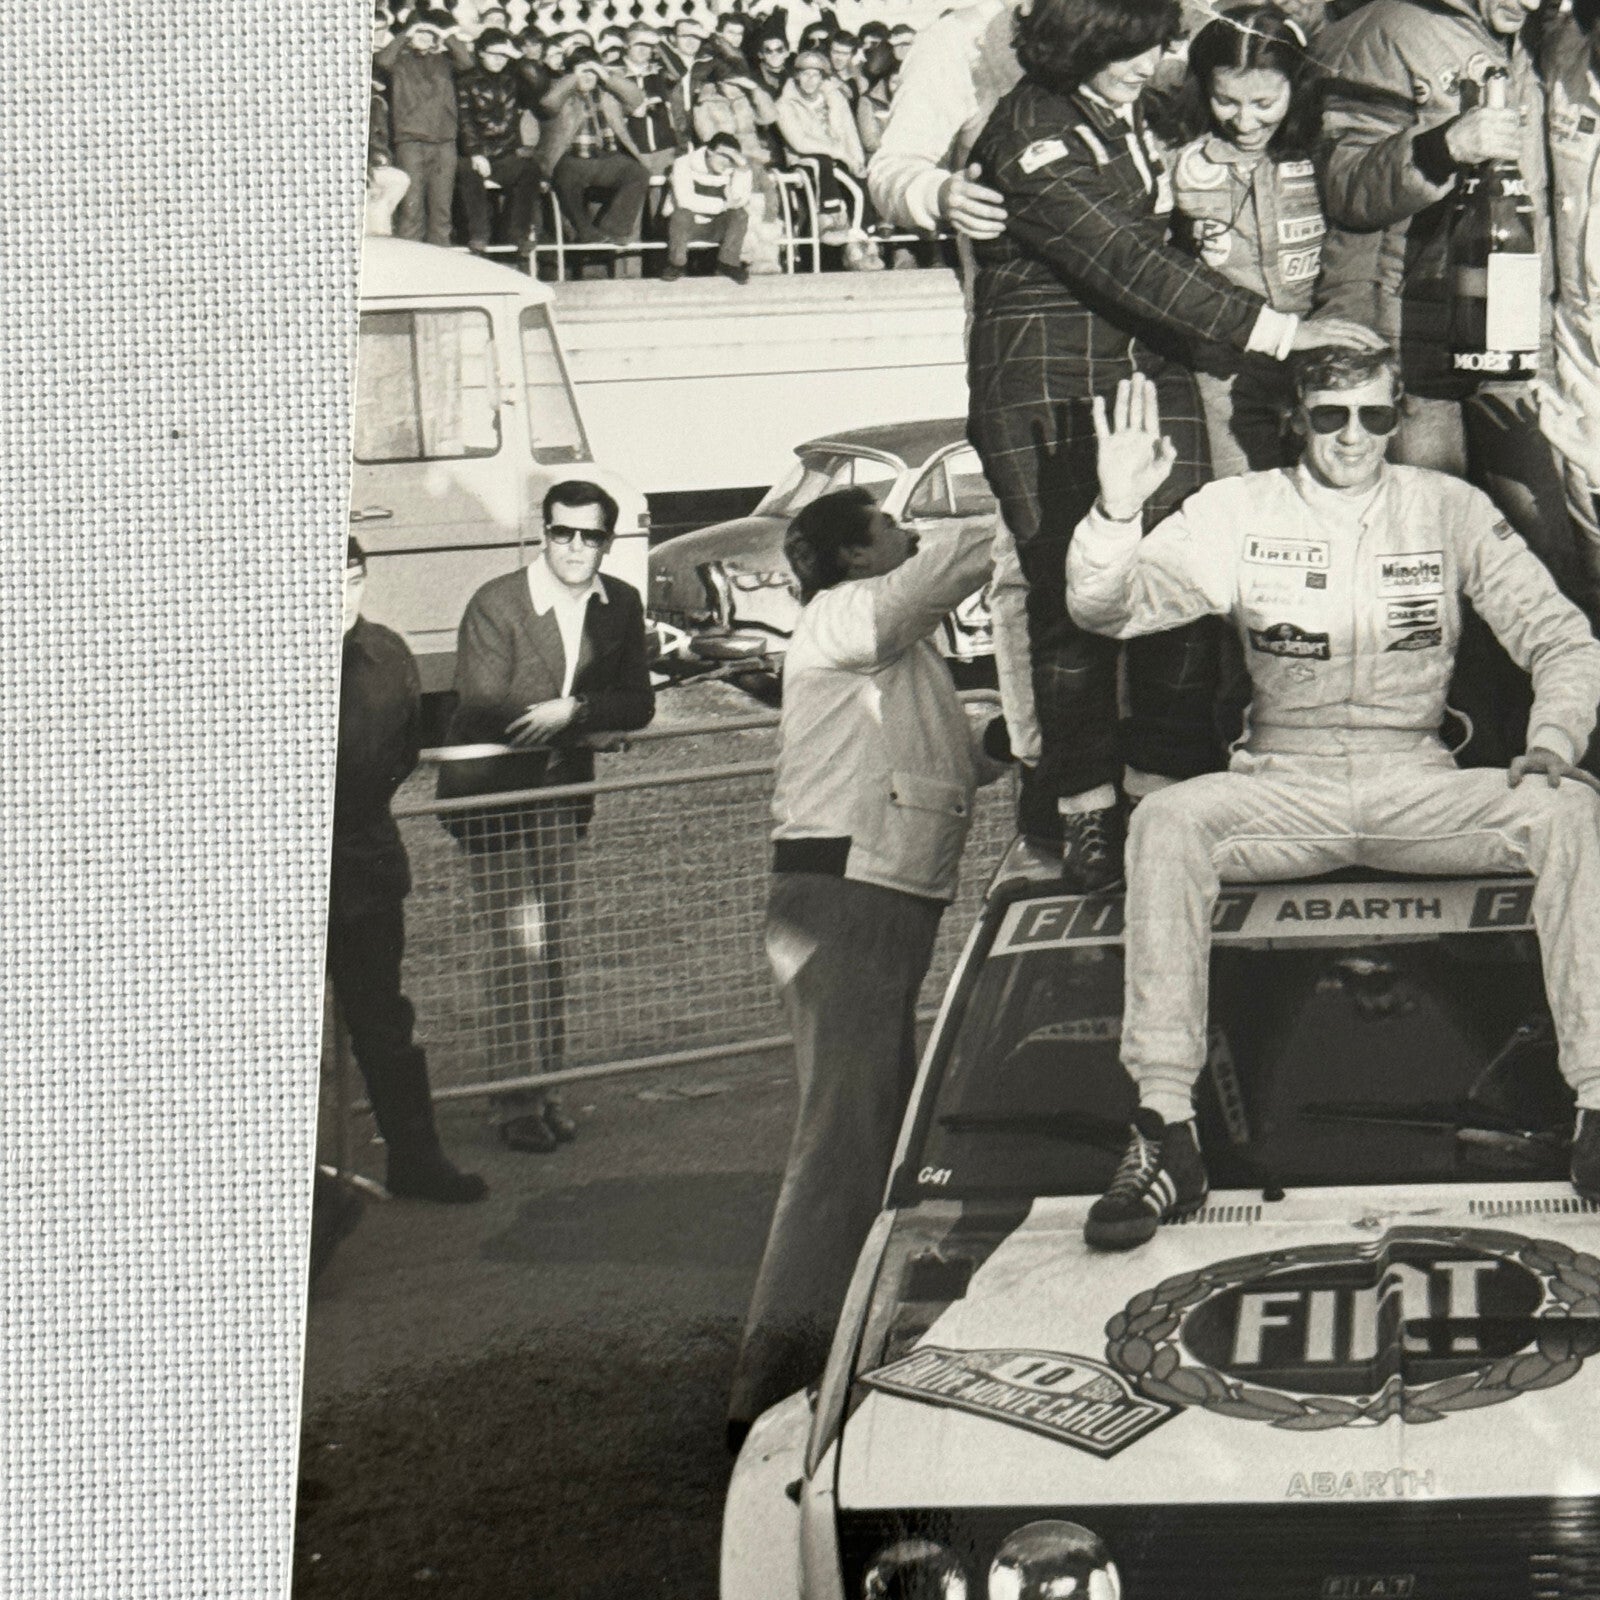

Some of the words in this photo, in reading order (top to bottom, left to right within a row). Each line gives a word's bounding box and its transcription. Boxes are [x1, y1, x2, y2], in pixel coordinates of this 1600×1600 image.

[1250, 541, 1324, 563] PIRELLI
[1381, 560, 1441, 578] Minolta
[1275, 897, 1443, 922] ABARTH
[1231, 1259, 1499, 1365] FIAT
[1013, 1361, 1075, 1386] 10
[953, 1378, 1155, 1442] MONTE-CARLO
[1285, 1467, 1435, 1498] ABARTH
[1328, 1577, 1408, 1596] FIAT
